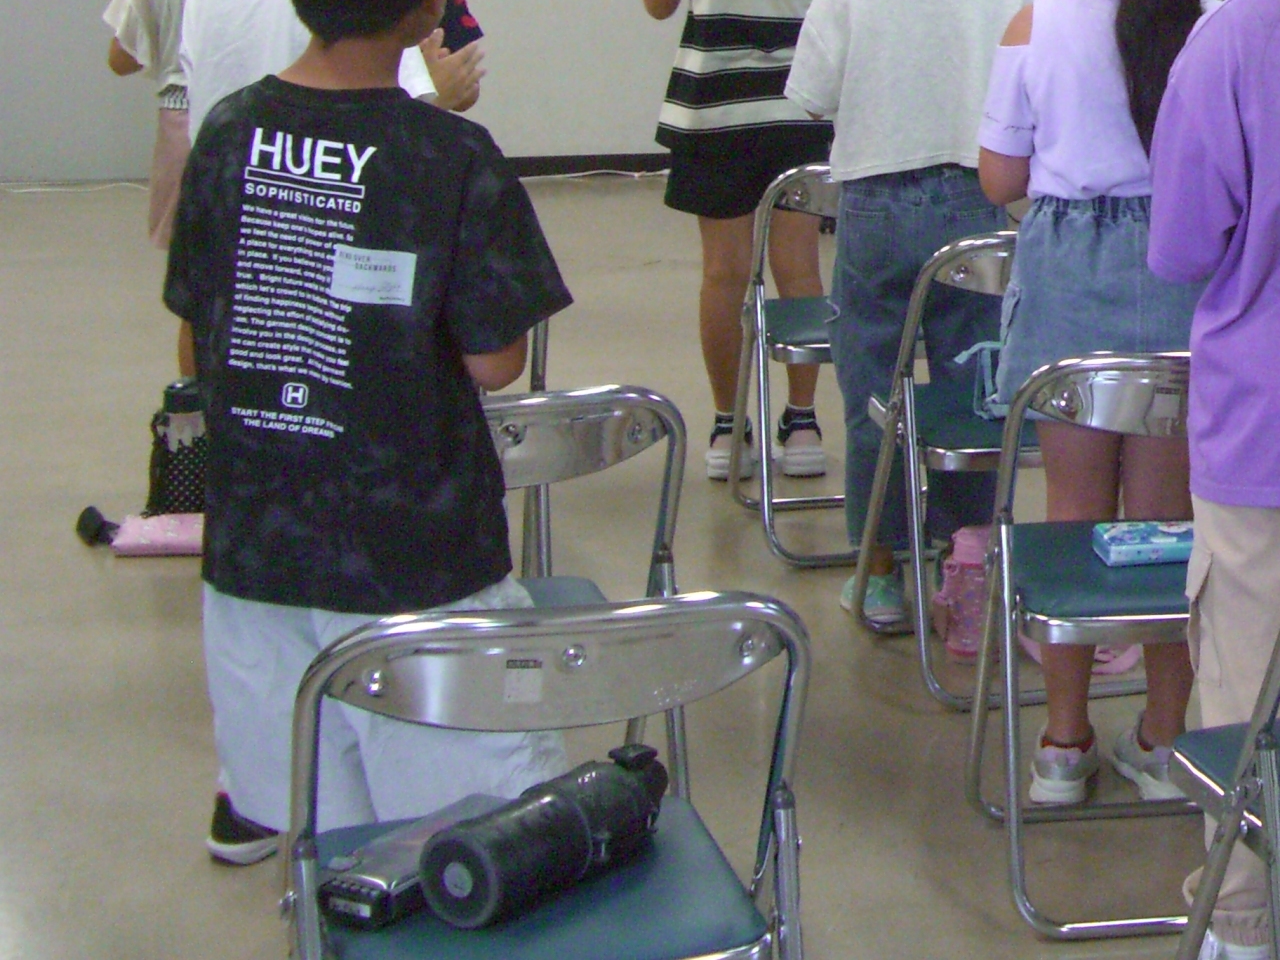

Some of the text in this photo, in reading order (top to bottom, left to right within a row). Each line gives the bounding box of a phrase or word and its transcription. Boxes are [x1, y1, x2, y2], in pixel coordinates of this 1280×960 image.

[250, 127, 378, 183] HUEY
[244, 182, 362, 214] SOPHISTICATED
[246, 239, 267, 248] place
[243, 294, 270, 305] finding
[271, 298, 306, 309] happiness
[233, 305, 272, 316] neglecting
[257, 341, 281, 349] create
[231, 406, 259, 417] START
[260, 410, 277, 420] THE
[278, 412, 304, 423] FIRST
[304, 416, 325, 426] STEP
[243, 418, 335, 439] THE LAND OF DREAMS
